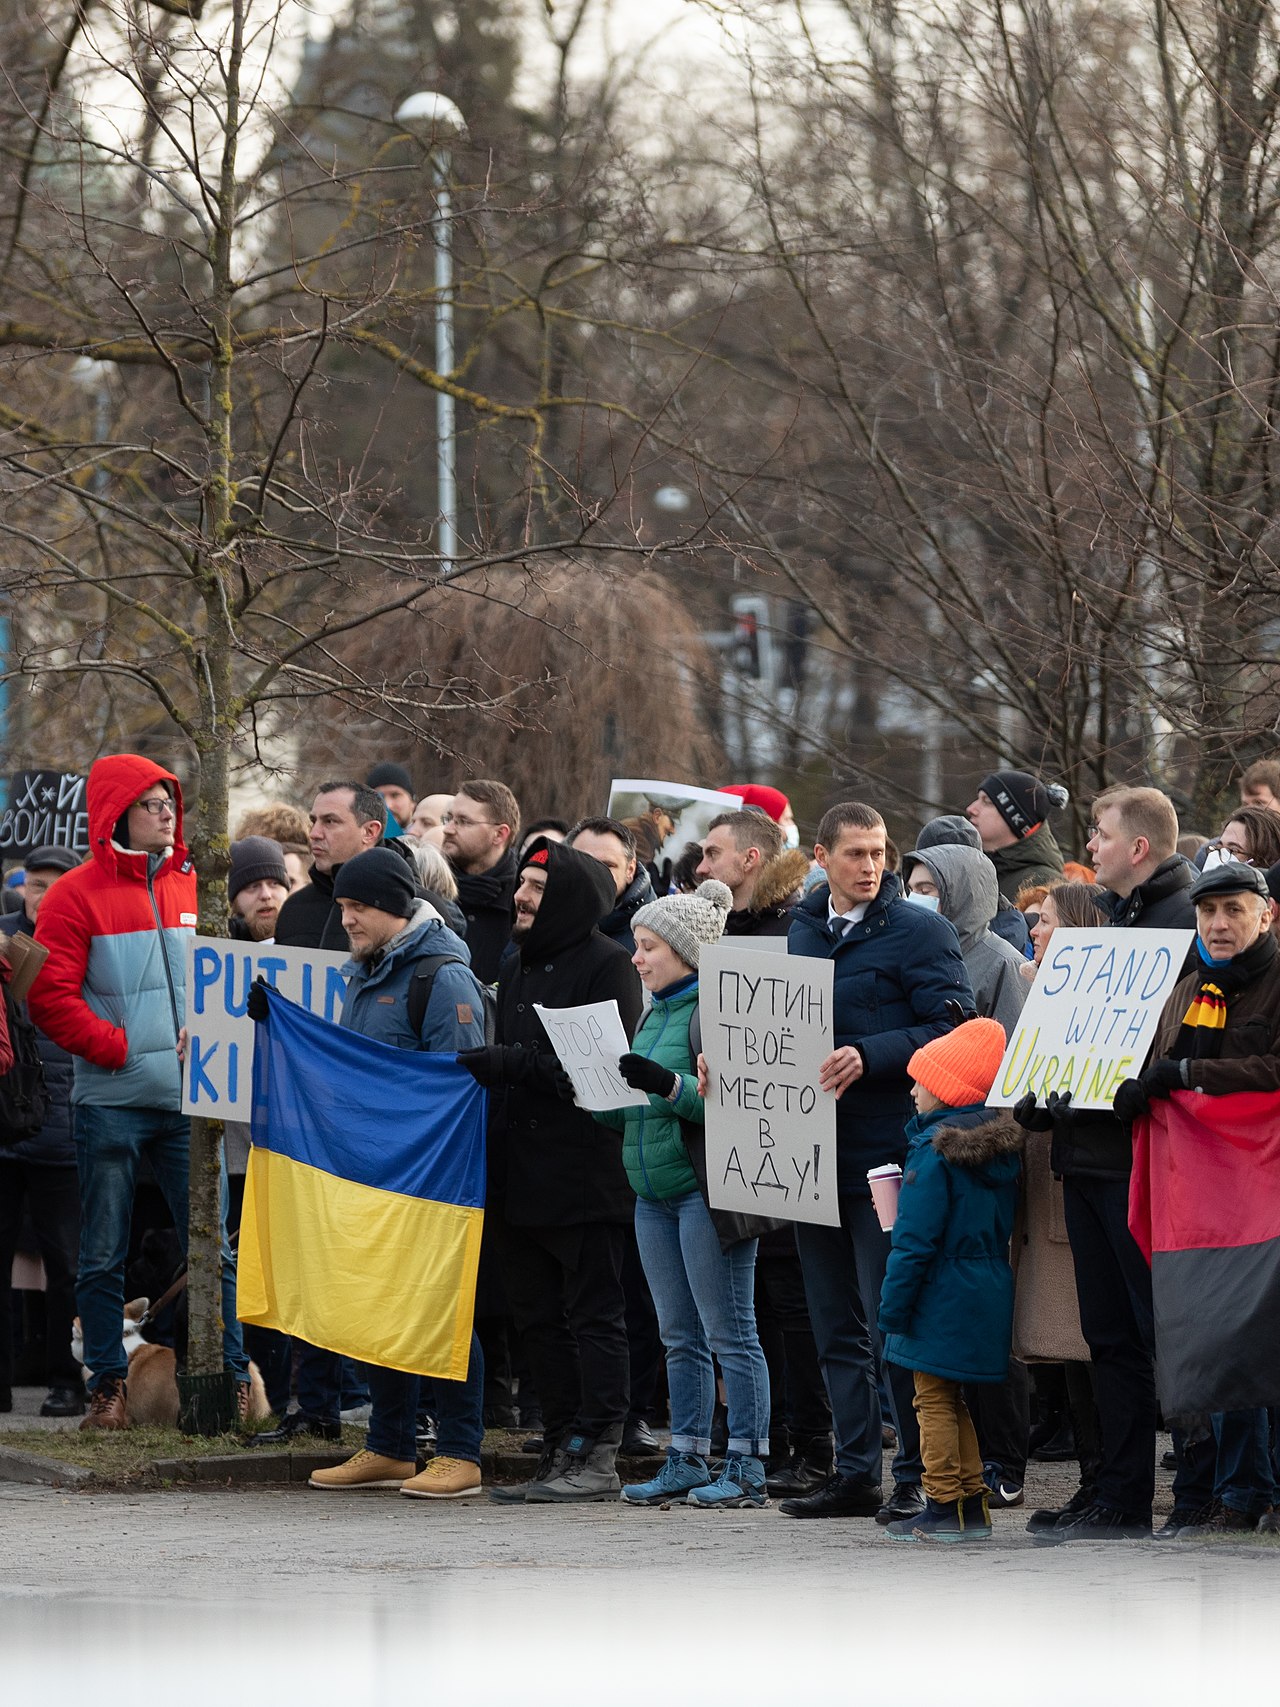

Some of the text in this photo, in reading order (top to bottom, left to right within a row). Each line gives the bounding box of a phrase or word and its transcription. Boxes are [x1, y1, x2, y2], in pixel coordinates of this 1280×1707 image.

[0, 806, 89, 850] ВОЙНЕ
[1043, 944, 1172, 1001] STAND
[719, 970, 827, 1035] ПУТИН,
[547, 1014, 604, 1057] STOP
[718, 1023, 796, 1067] ТВОЁ
[719, 1073, 816, 1115] МЕСТО
[759, 1118, 776, 1149] В
[722, 1144, 821, 1203] АДУ!
